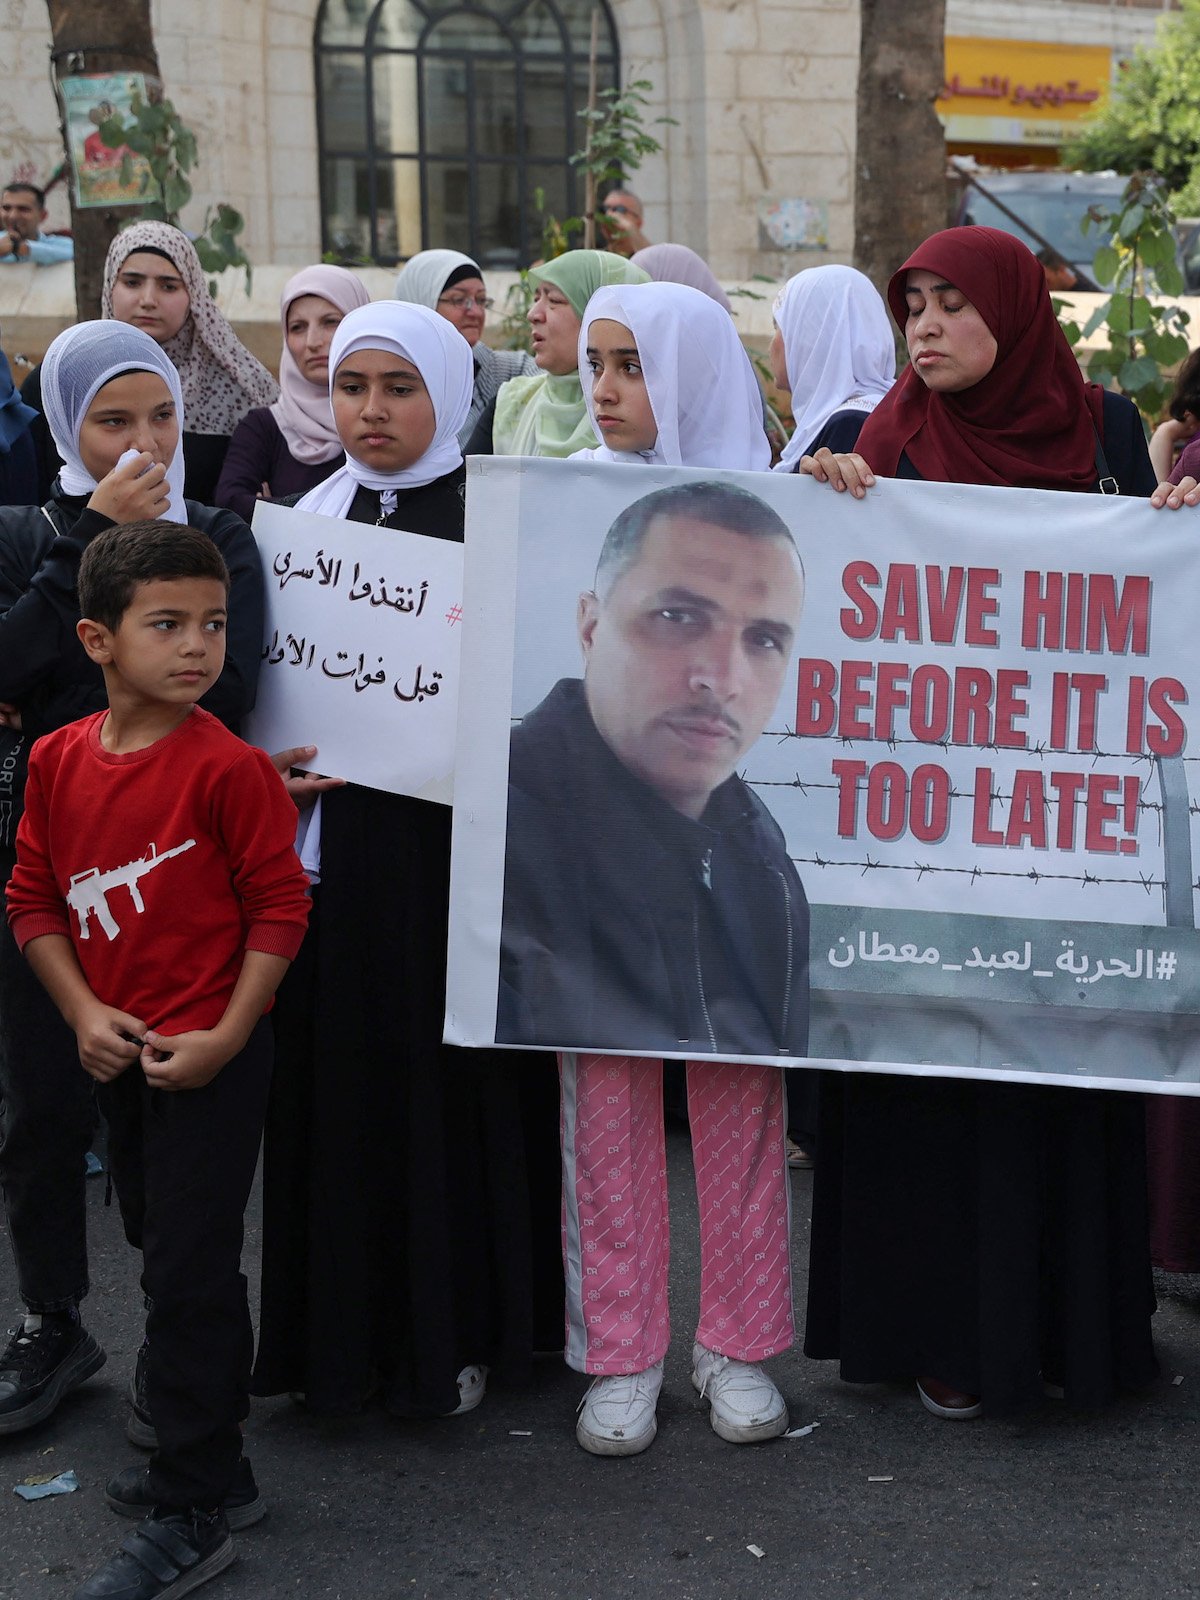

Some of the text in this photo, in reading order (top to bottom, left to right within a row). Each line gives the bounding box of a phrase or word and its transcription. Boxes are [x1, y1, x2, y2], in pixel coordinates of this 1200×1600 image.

[349, 562, 429, 618] أنقذوا
[839, 560, 1153, 657] SAVE HIM
[321, 652, 387, 693] فوات
[393, 664, 443, 703] قبل
[795, 657, 1189, 758] BEFORE IT IS
[831, 759, 1144, 857] TOO LATE!
